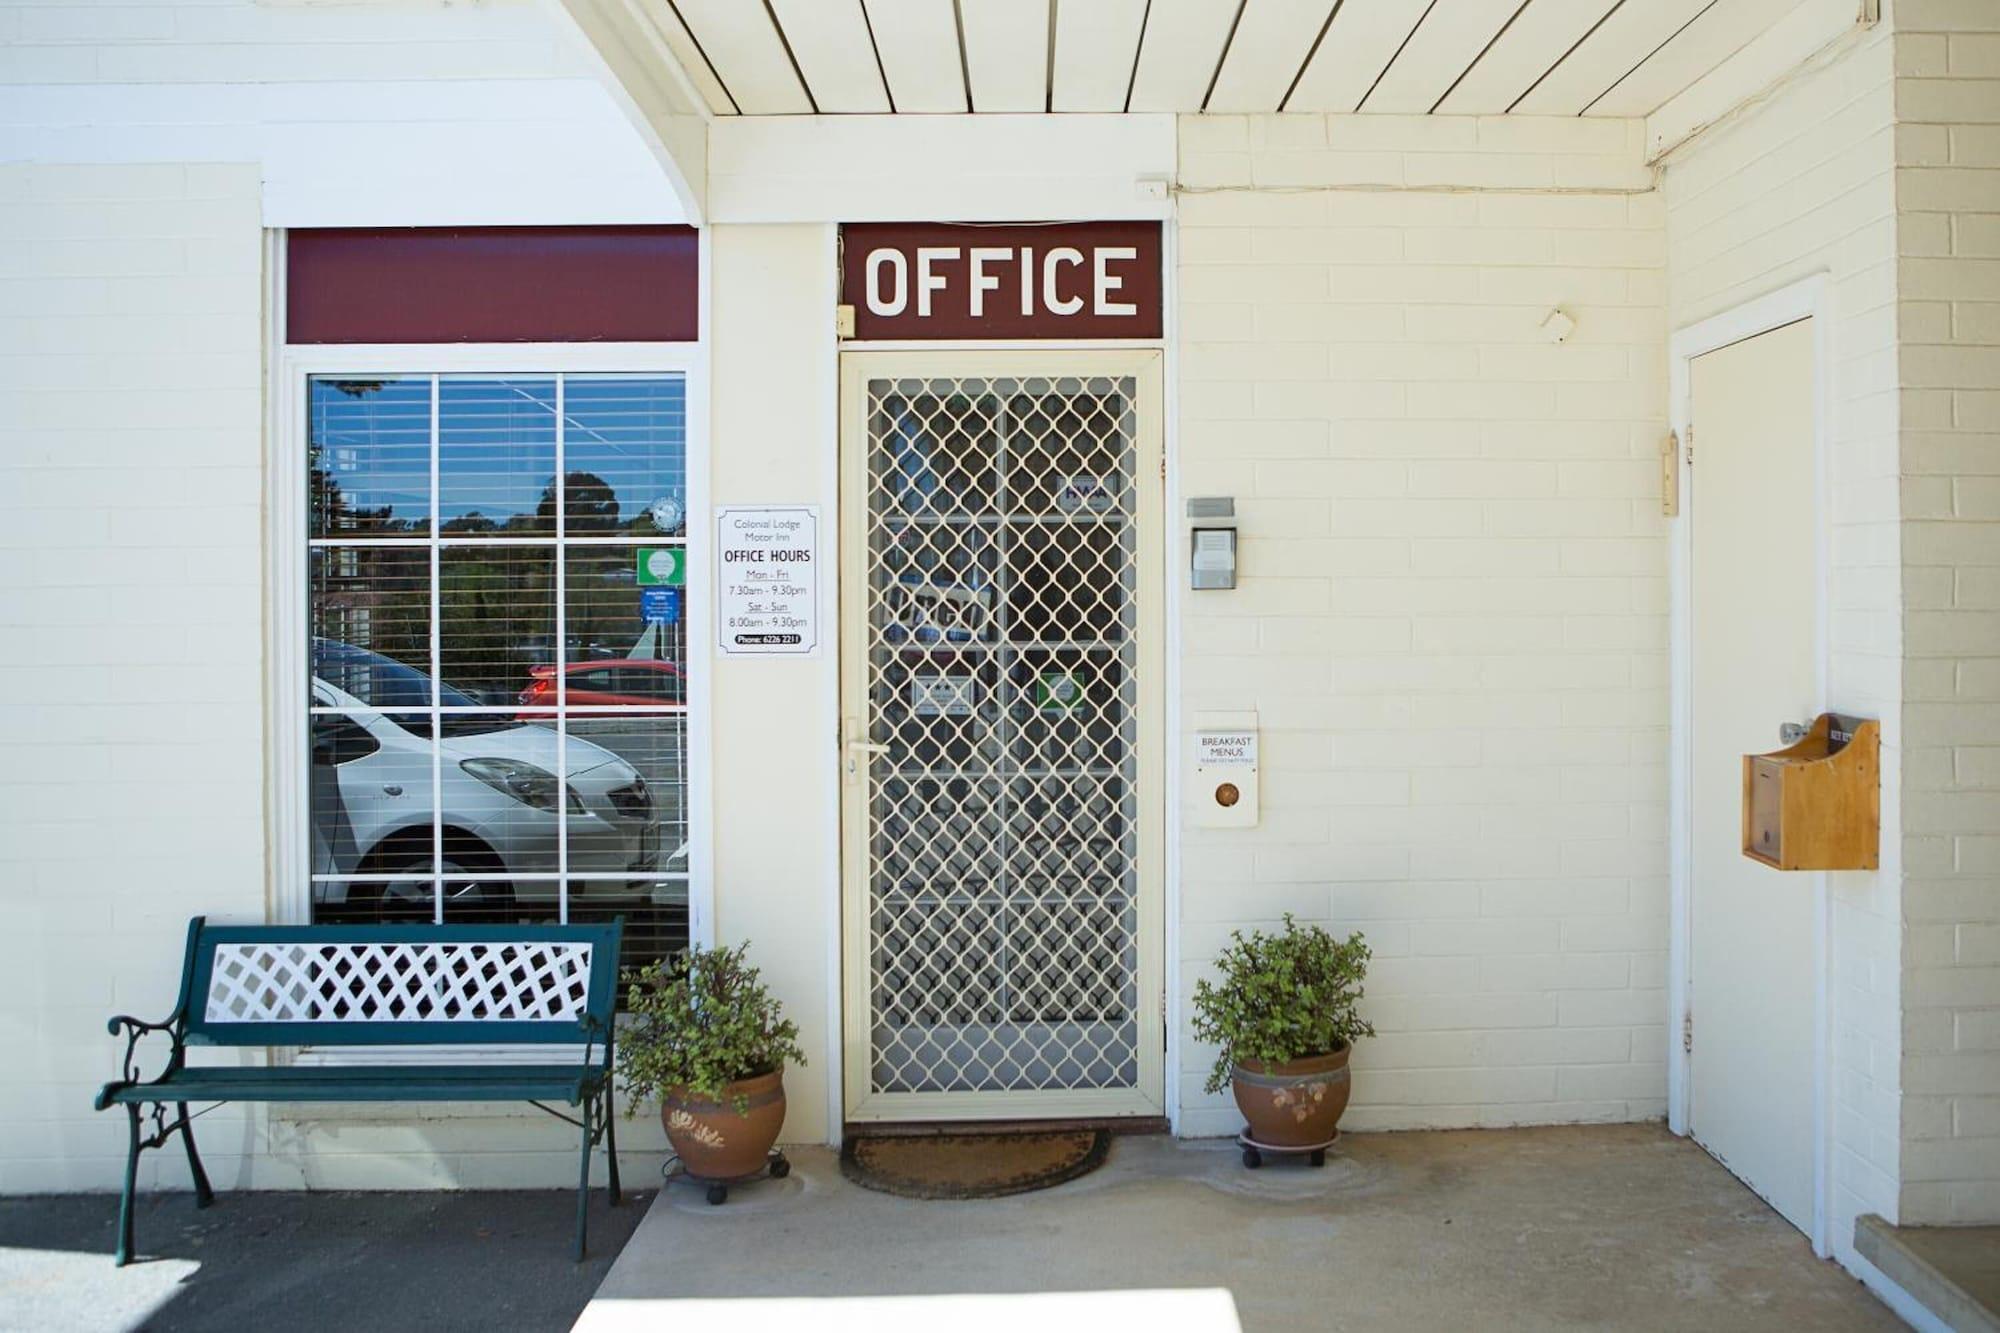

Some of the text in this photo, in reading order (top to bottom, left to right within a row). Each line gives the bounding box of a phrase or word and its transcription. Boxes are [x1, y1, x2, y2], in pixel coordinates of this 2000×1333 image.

[866, 247, 1137, 317] OFFICE
[734, 519, 800, 531] Colonial Lodge
[744, 533, 790, 542] Motor Inn
[724, 550, 810, 562] OFFICE HOURS
[746, 570, 767, 579] Mon
[777, 569, 789, 579] Fri
[729, 586, 763, 596] 7.30am
[772, 585, 806, 598] 9.30pm
[748, 602, 762, 611] Sat
[771, 602, 788, 611] Sun
[729, 617, 763, 627] 8.00am
[772, 616, 807, 629] 9.30pm
[1202, 738, 1251, 746] BREAKFAST
[1210, 748, 1244, 756] MENUS
